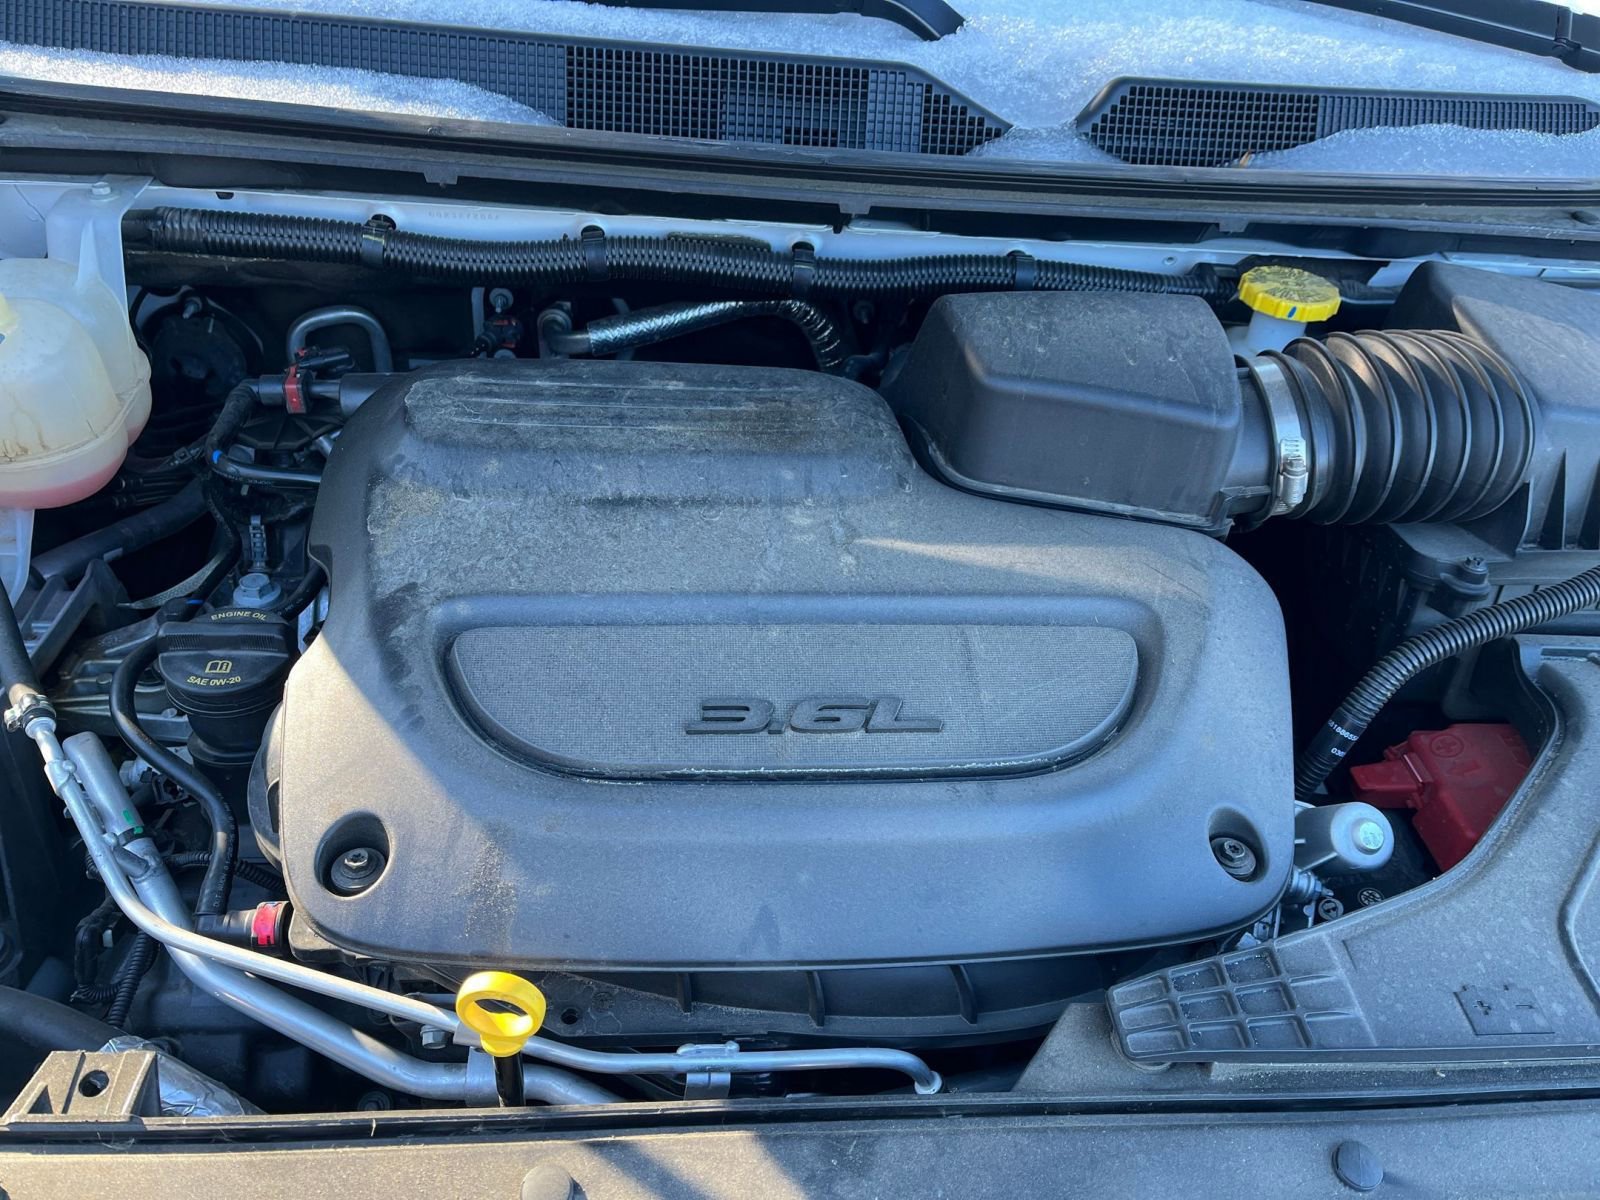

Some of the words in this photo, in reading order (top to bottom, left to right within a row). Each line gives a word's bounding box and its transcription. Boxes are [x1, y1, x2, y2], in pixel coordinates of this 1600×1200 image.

[210, 611, 250, 621] ENGINE
[252, 611, 268, 621] OIL
[187, 675, 208, 686] SAE
[209, 676, 241, 687] 0W-20
[685, 696, 944, 735] 3.6L
